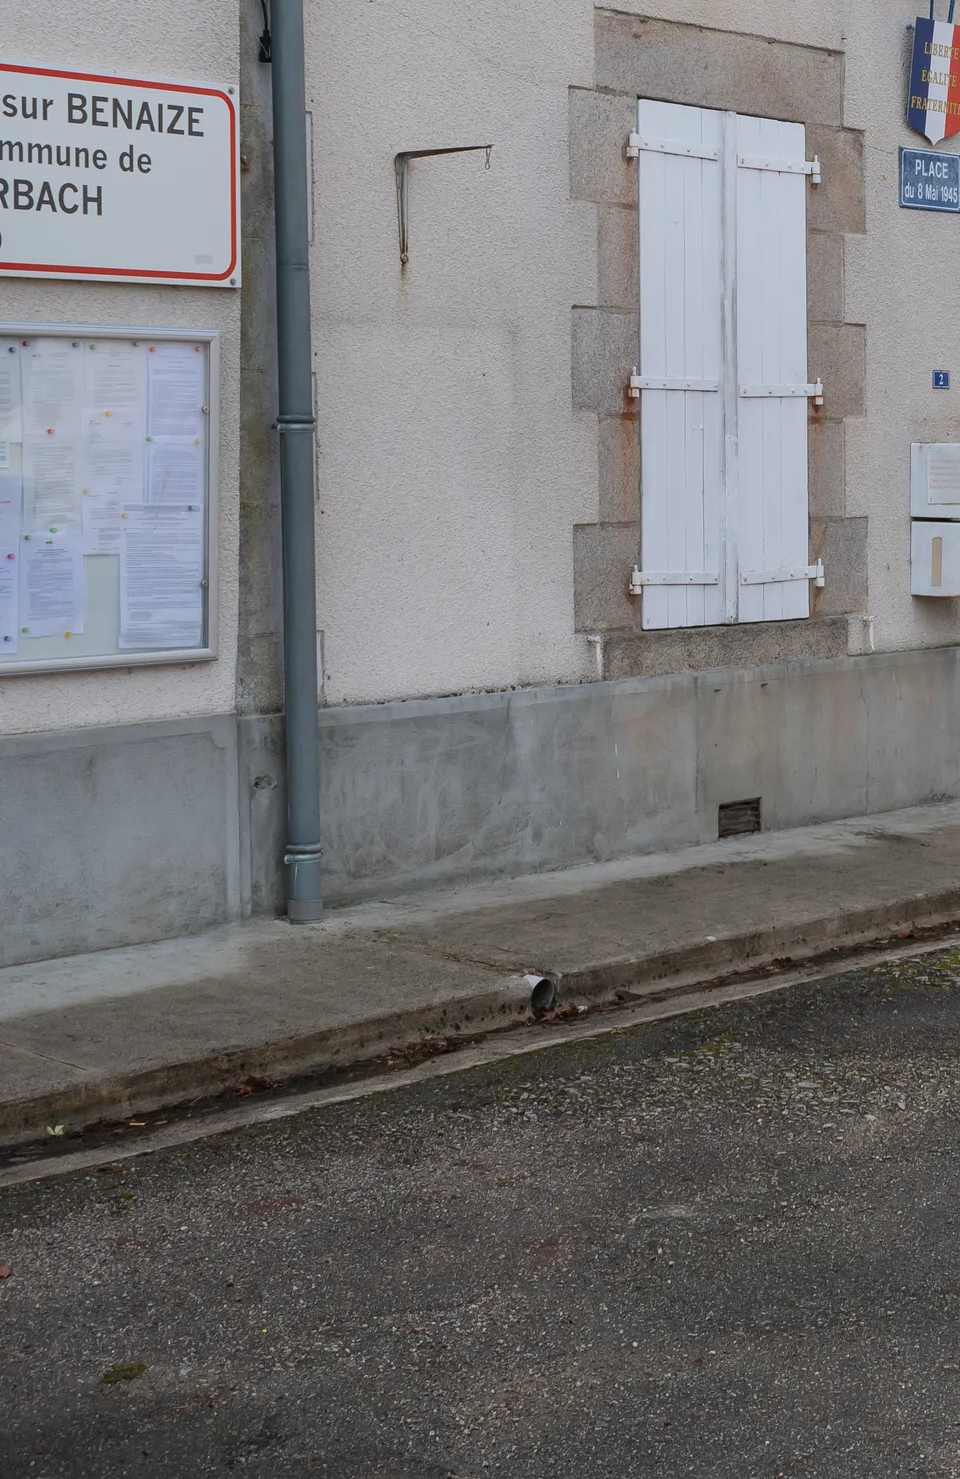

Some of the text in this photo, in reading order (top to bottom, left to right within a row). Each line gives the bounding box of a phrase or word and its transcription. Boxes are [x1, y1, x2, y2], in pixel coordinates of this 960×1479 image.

[924, 41, 959, 60] LIBERTÉ
[921, 66, 957, 88] ÉGALITÉ
[2, 93, 204, 137] sur BENAIZE
[119, 144, 152, 173] de
[915, 159, 948, 179] PLACE
[904, 182, 958, 203] du 8 Mai 1945
[938, 373, 944, 385] 2
